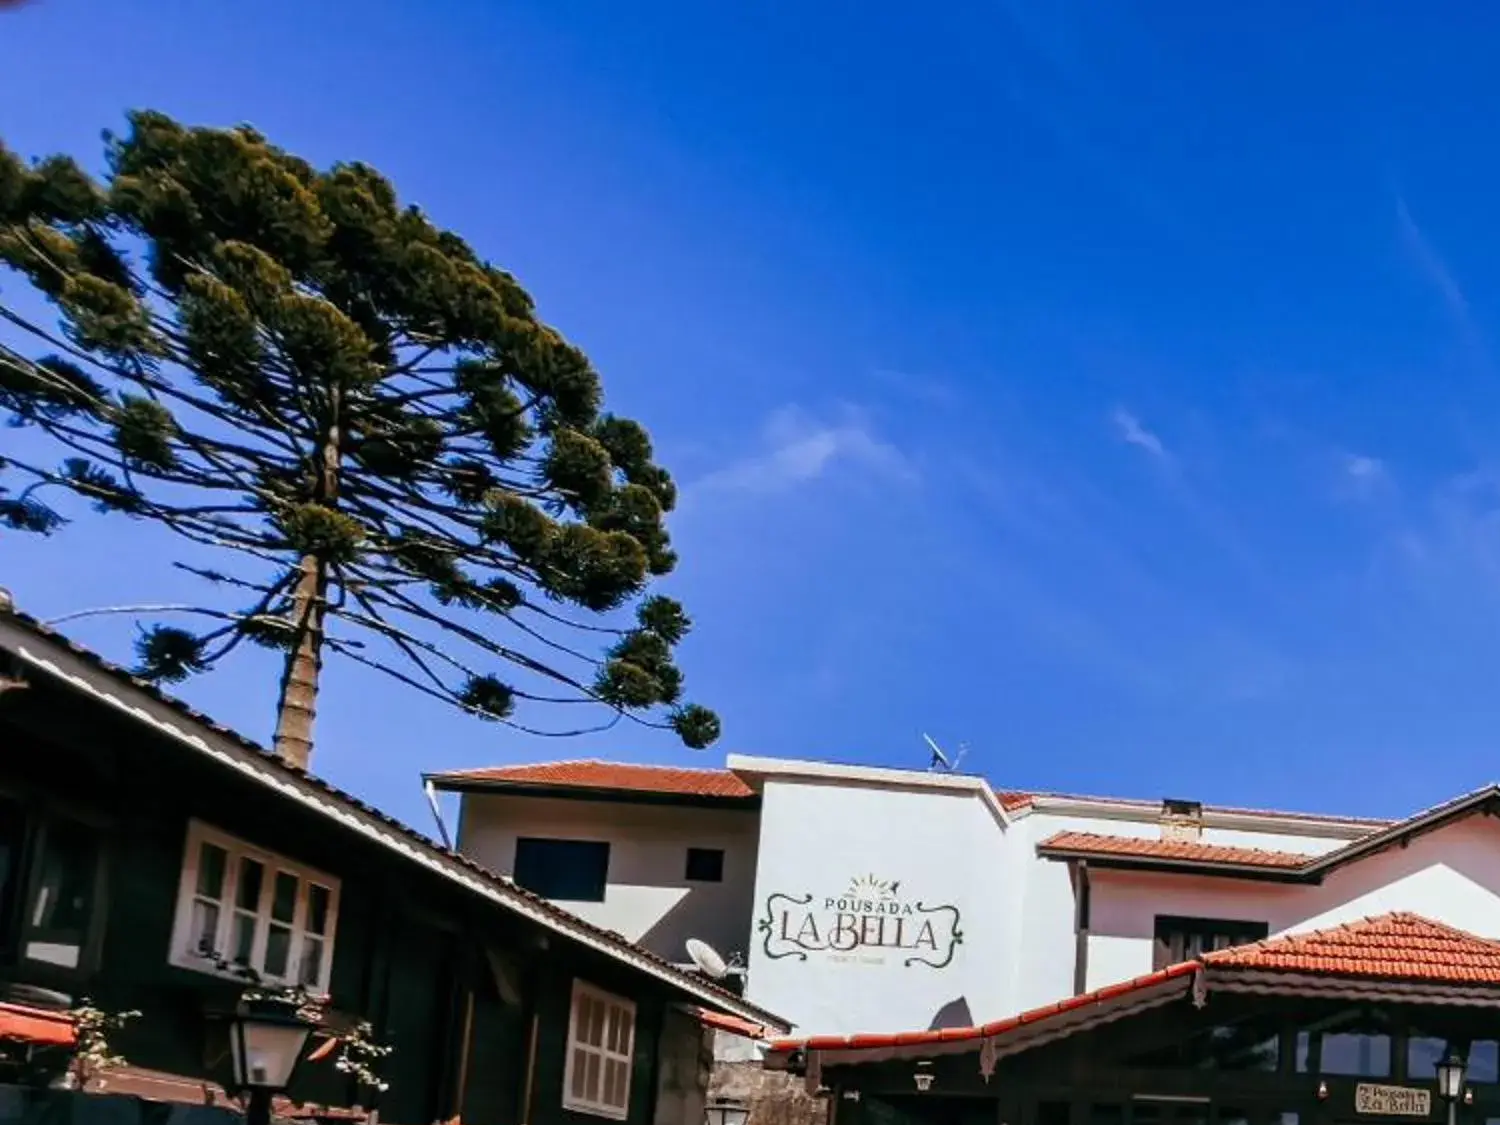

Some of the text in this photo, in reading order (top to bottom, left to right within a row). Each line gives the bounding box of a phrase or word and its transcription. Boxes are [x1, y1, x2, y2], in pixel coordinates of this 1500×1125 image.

[825, 897, 914, 915] POUSADA
[780, 910, 938, 951] LA BELLA
